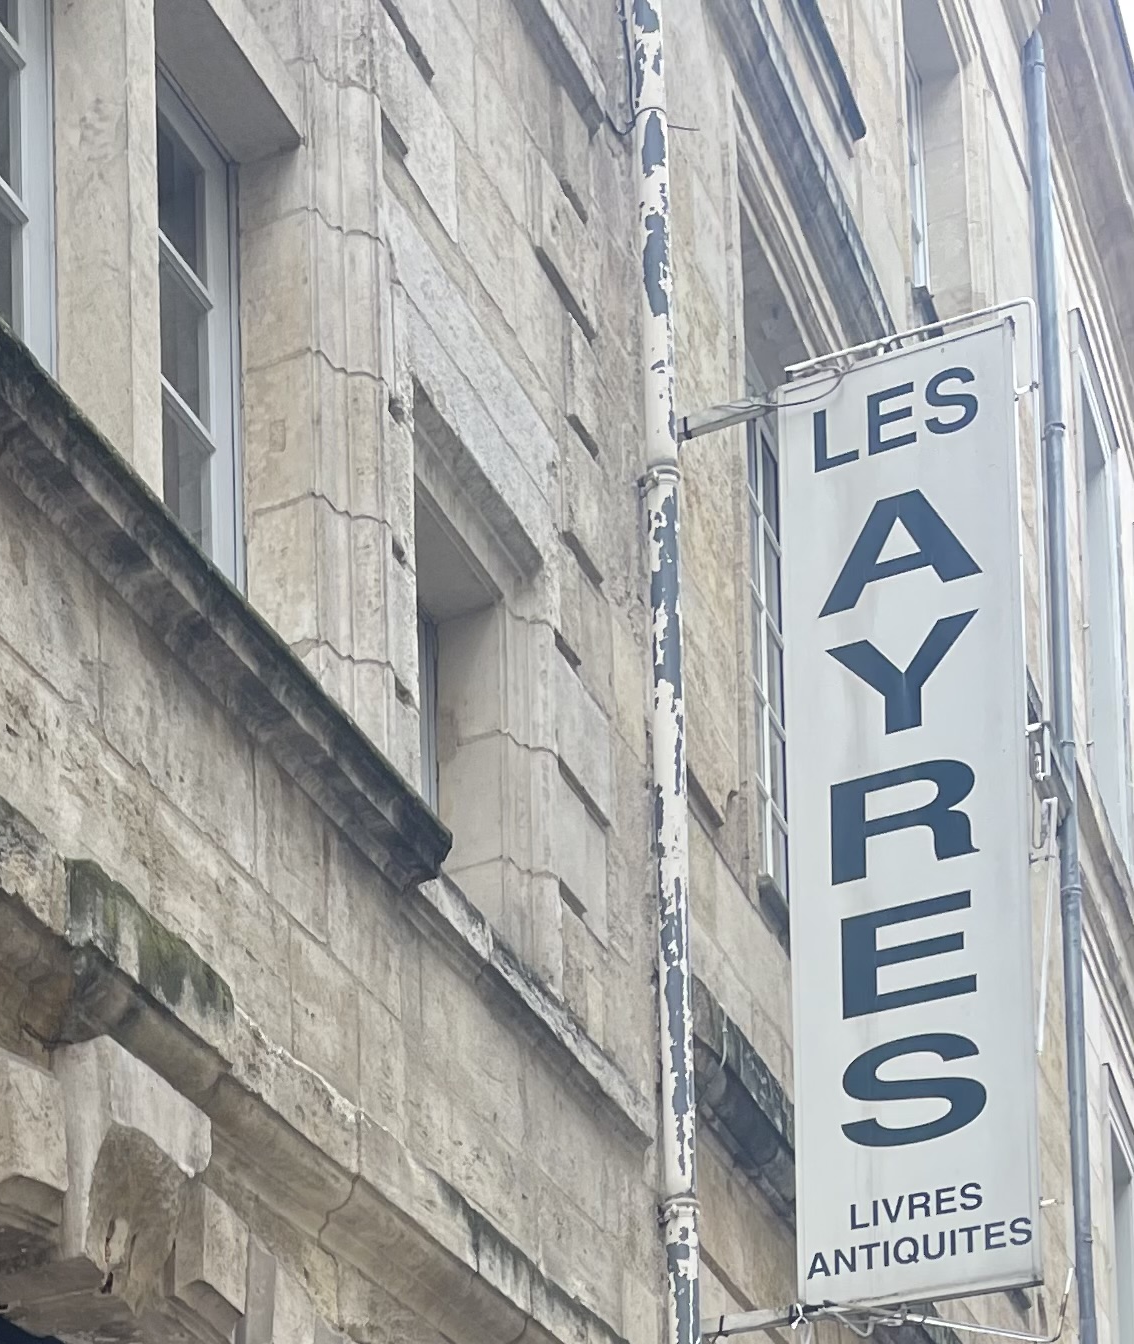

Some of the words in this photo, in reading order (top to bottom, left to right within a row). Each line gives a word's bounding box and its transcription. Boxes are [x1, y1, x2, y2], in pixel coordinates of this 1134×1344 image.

[813, 366, 979, 473] LES
[818, 488, 987, 1148] AYRES
[807, 1216, 1033, 1280] ANTIQUITES
[849, 1182, 984, 1231] LIVRES
